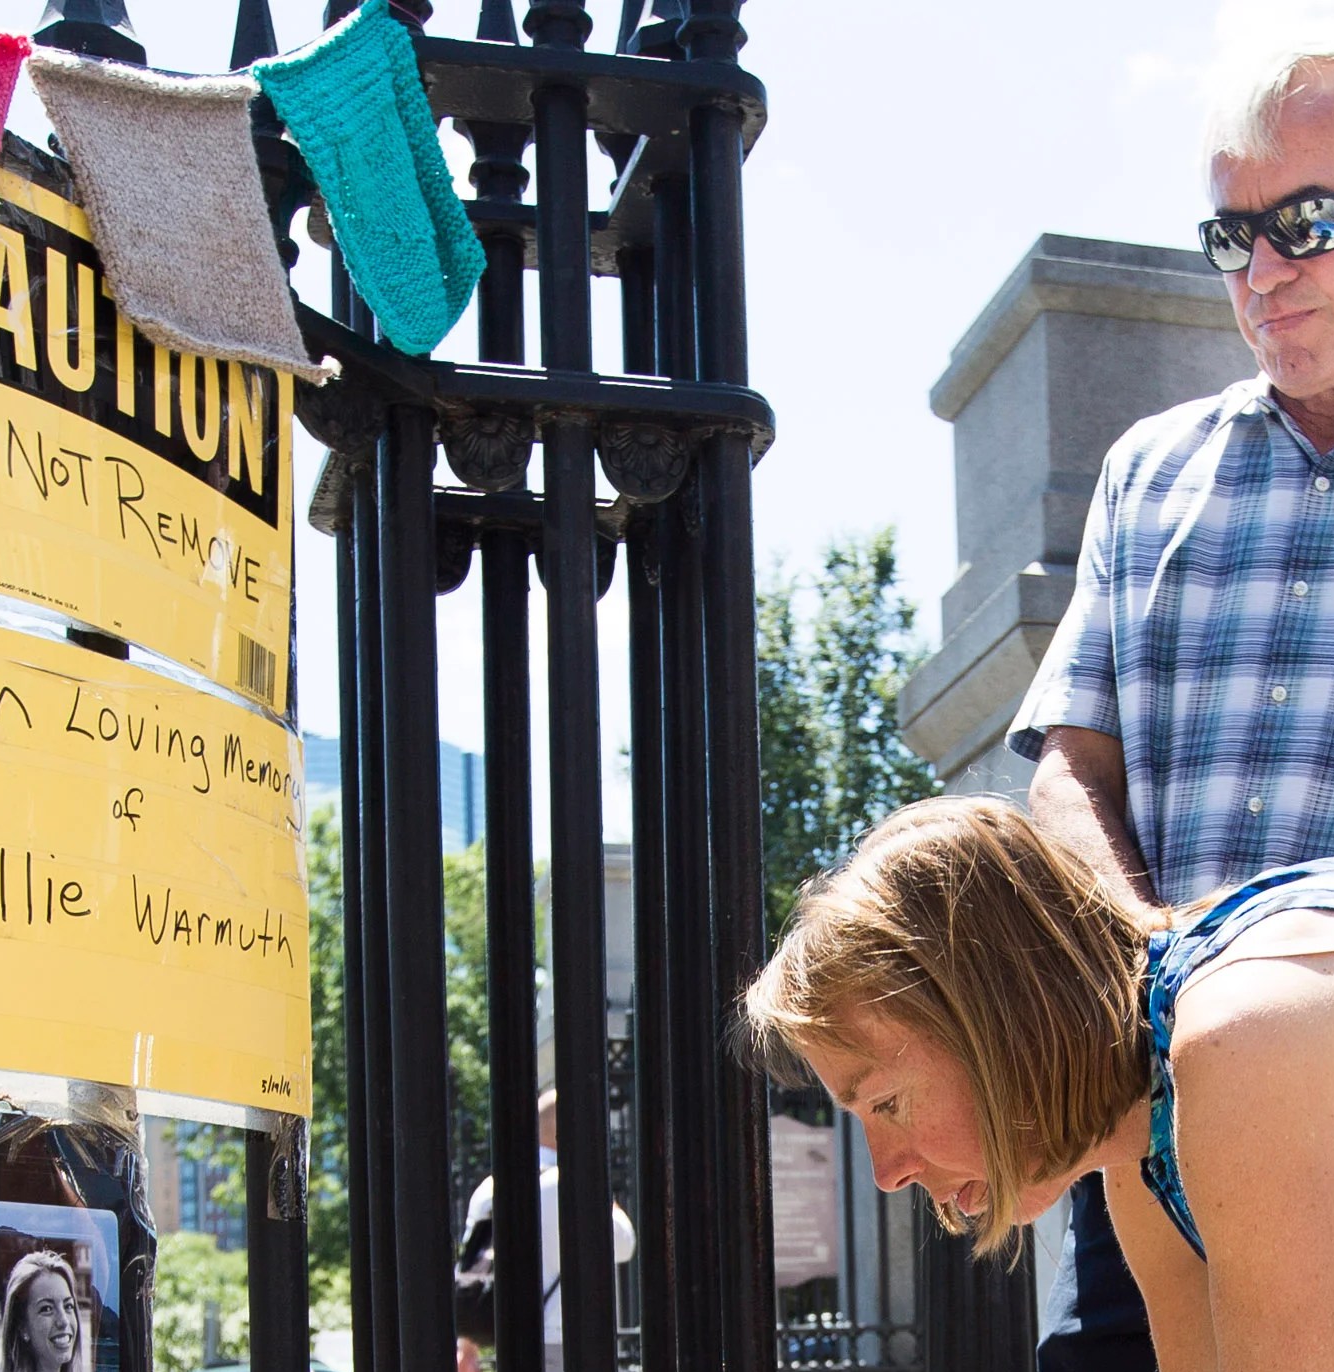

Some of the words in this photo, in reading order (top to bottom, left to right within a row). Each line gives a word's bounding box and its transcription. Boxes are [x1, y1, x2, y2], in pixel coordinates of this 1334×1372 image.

[66, 687, 212, 794] Loving
[224, 733, 304, 833] Memory
[113, 788, 144, 832] of
[261, 1074, 291, 1098] 5/19/16
